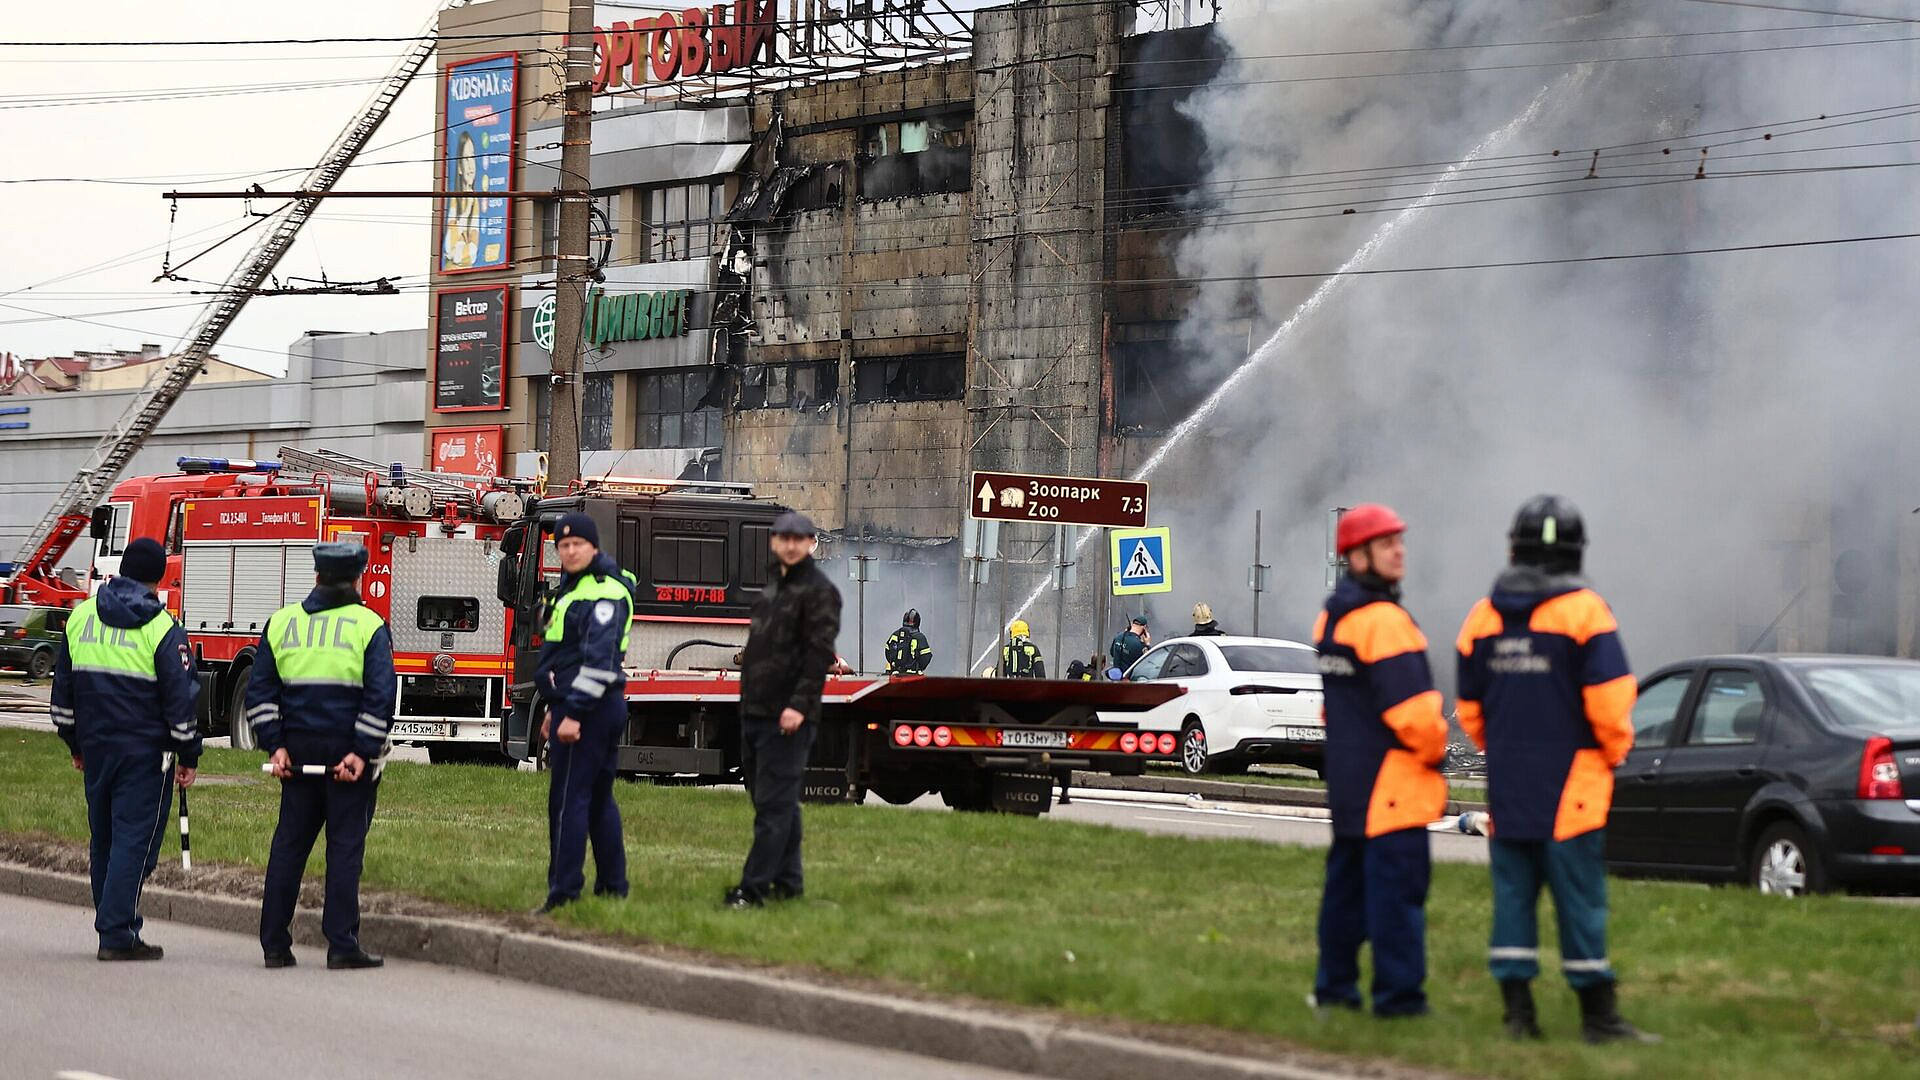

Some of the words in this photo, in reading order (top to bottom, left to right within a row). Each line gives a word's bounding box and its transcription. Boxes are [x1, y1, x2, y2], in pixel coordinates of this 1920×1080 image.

[1028, 481, 1101, 503] Зоопарк
[1028, 501, 1059, 518] Zoo
[1121, 497, 1143, 514] 7,3
[261, 512, 283, 525] Телефон
[674, 586, 725, 603] 90-77-88
[79, 614, 138, 650] ДПС
[281, 613, 358, 649] ДПС
[393, 723, 432, 734] Р415ХМ
[433, 723, 444, 732] 39
[1007, 732, 1050, 744] Т013МУ
[804, 786, 841, 797] IVECO
[1006, 791, 1040, 803] IVECO
